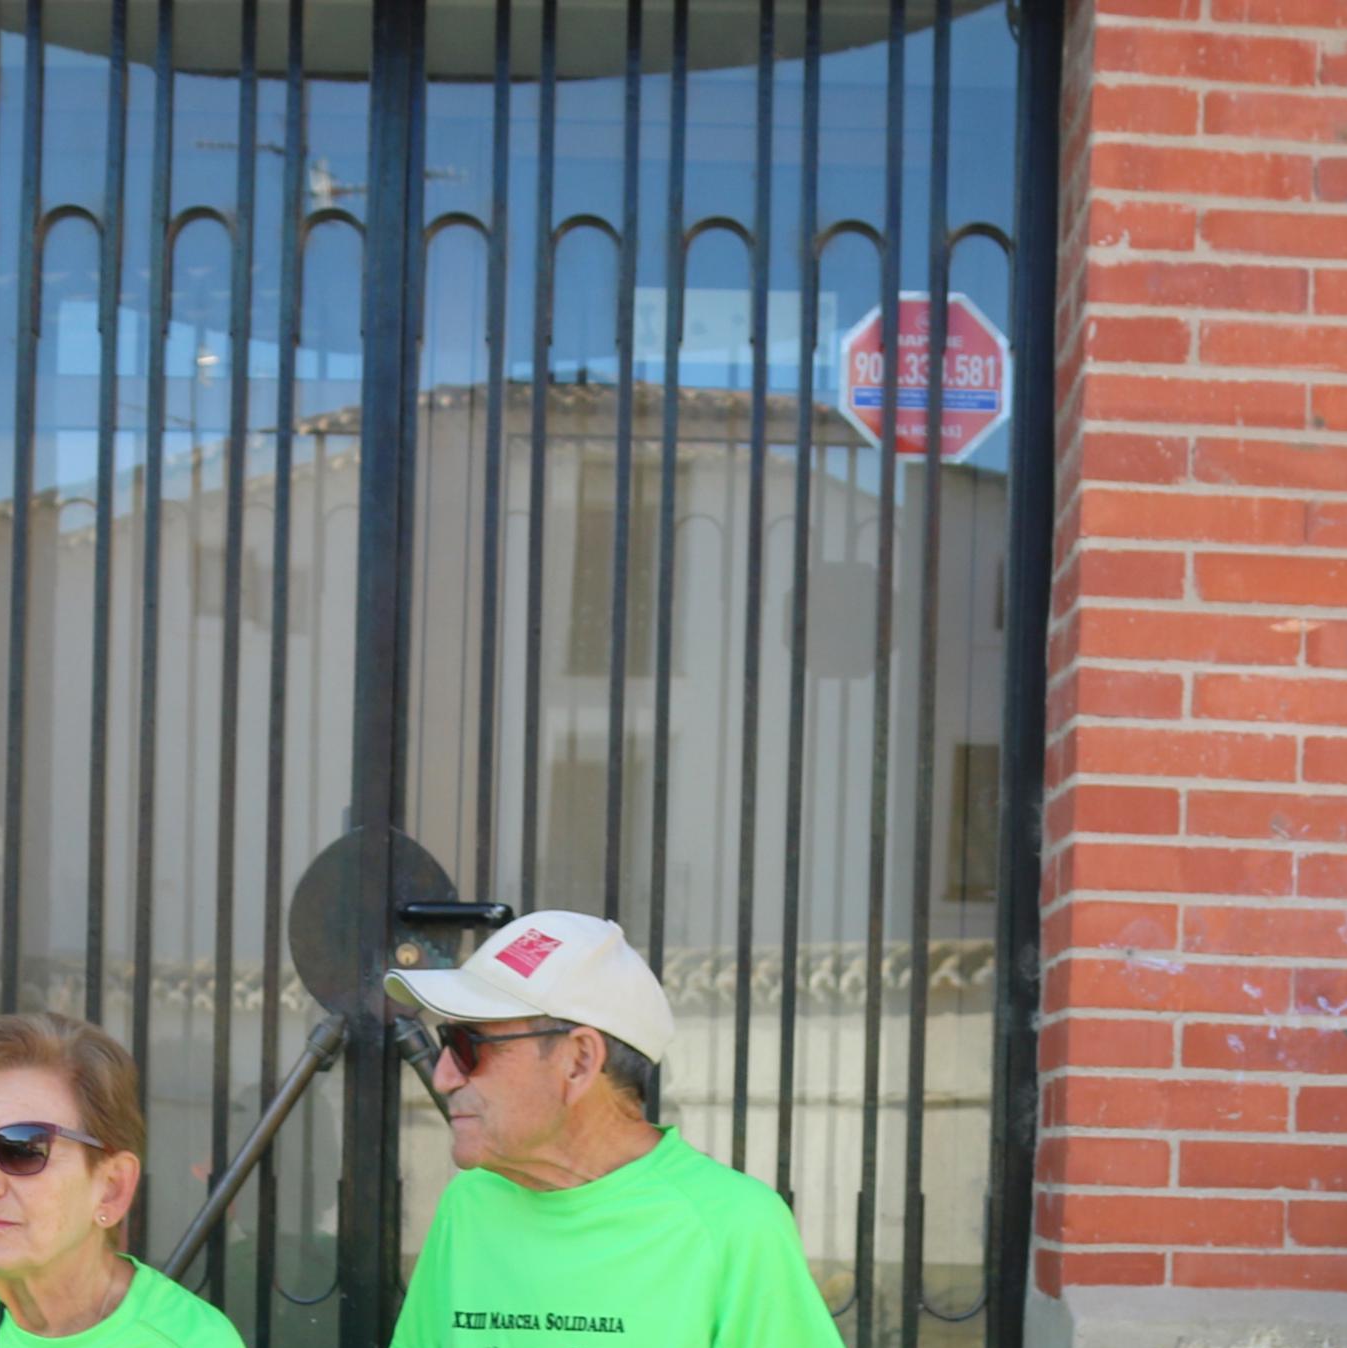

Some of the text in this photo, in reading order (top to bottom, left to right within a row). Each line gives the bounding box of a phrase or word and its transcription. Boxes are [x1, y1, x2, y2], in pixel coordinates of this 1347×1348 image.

[452, 1311, 626, 1334] XXIII MARCHA SOLIDARIA
